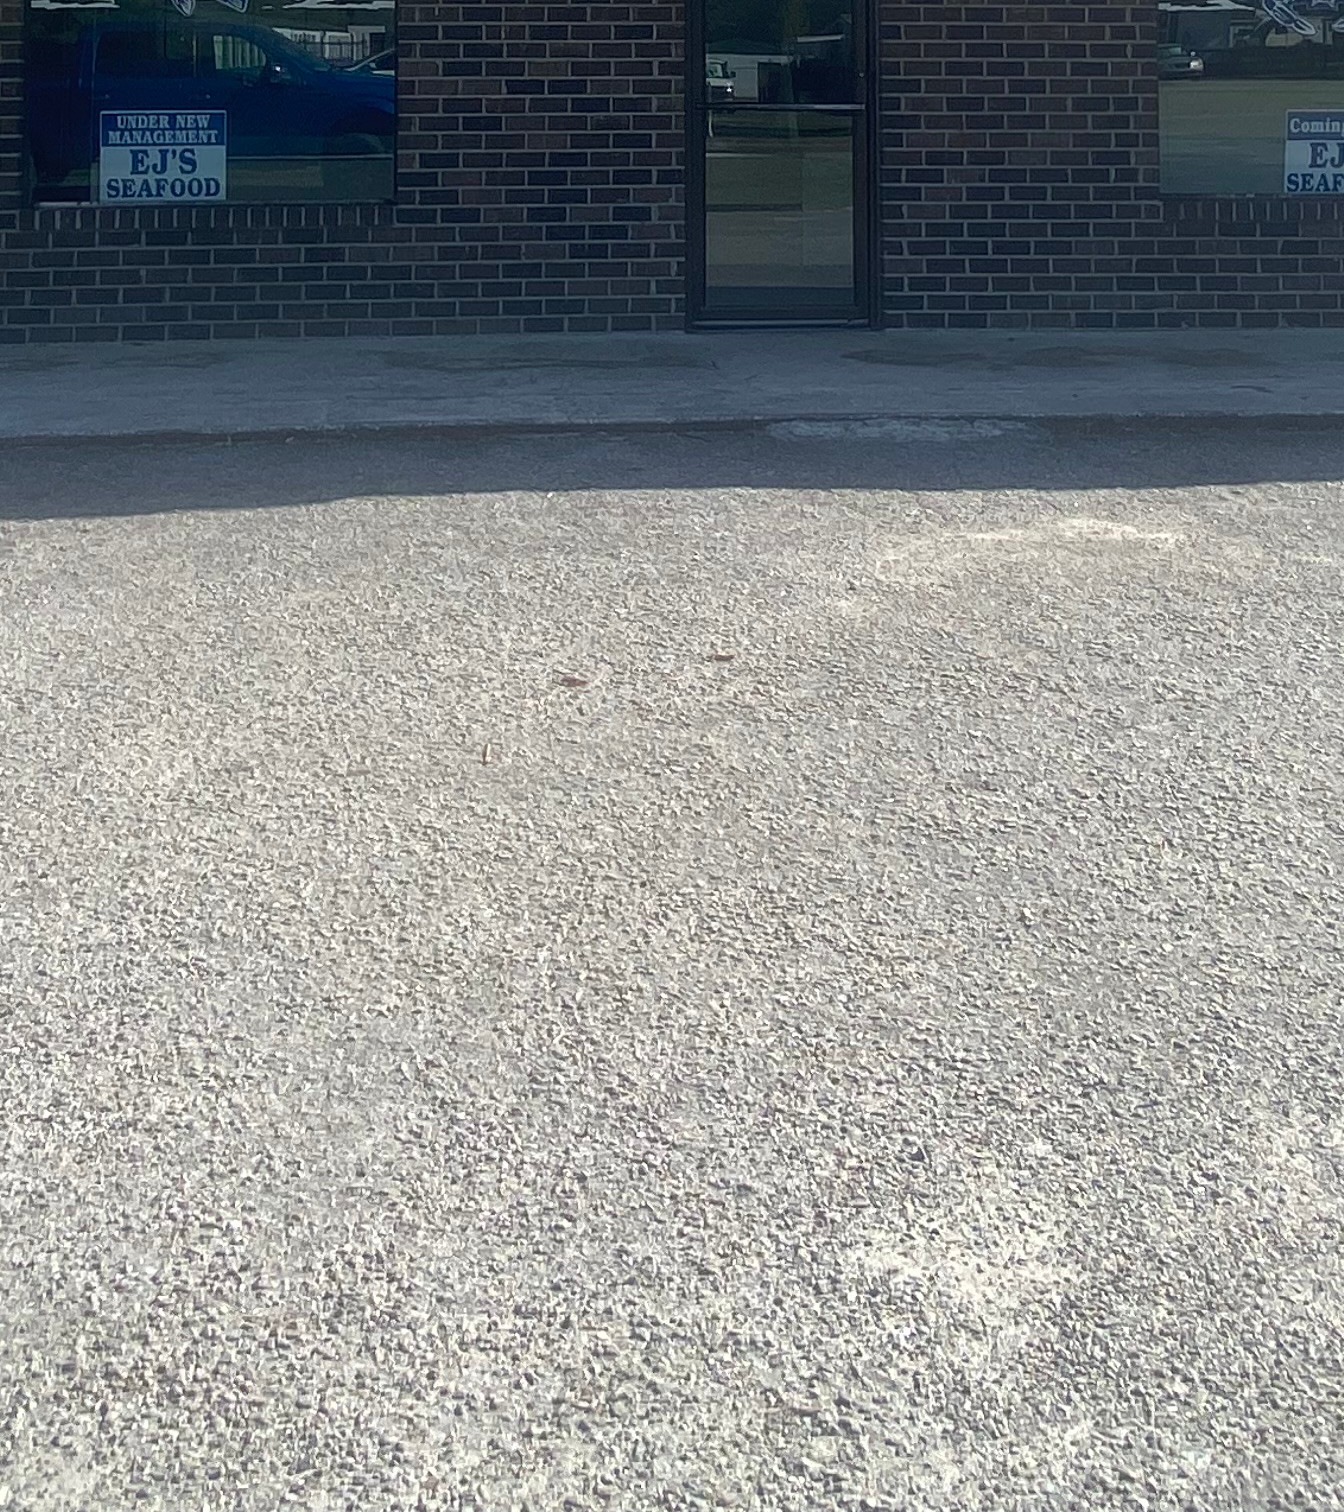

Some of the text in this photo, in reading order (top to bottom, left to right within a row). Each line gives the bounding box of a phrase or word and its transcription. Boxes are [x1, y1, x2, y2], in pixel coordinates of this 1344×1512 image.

[116, 114, 211, 129] UNDER NEW
[108, 130, 218, 144] MANAGEMENT
[130, 148, 197, 175] EJ'S
[106, 178, 221, 198] SEAFOOD
